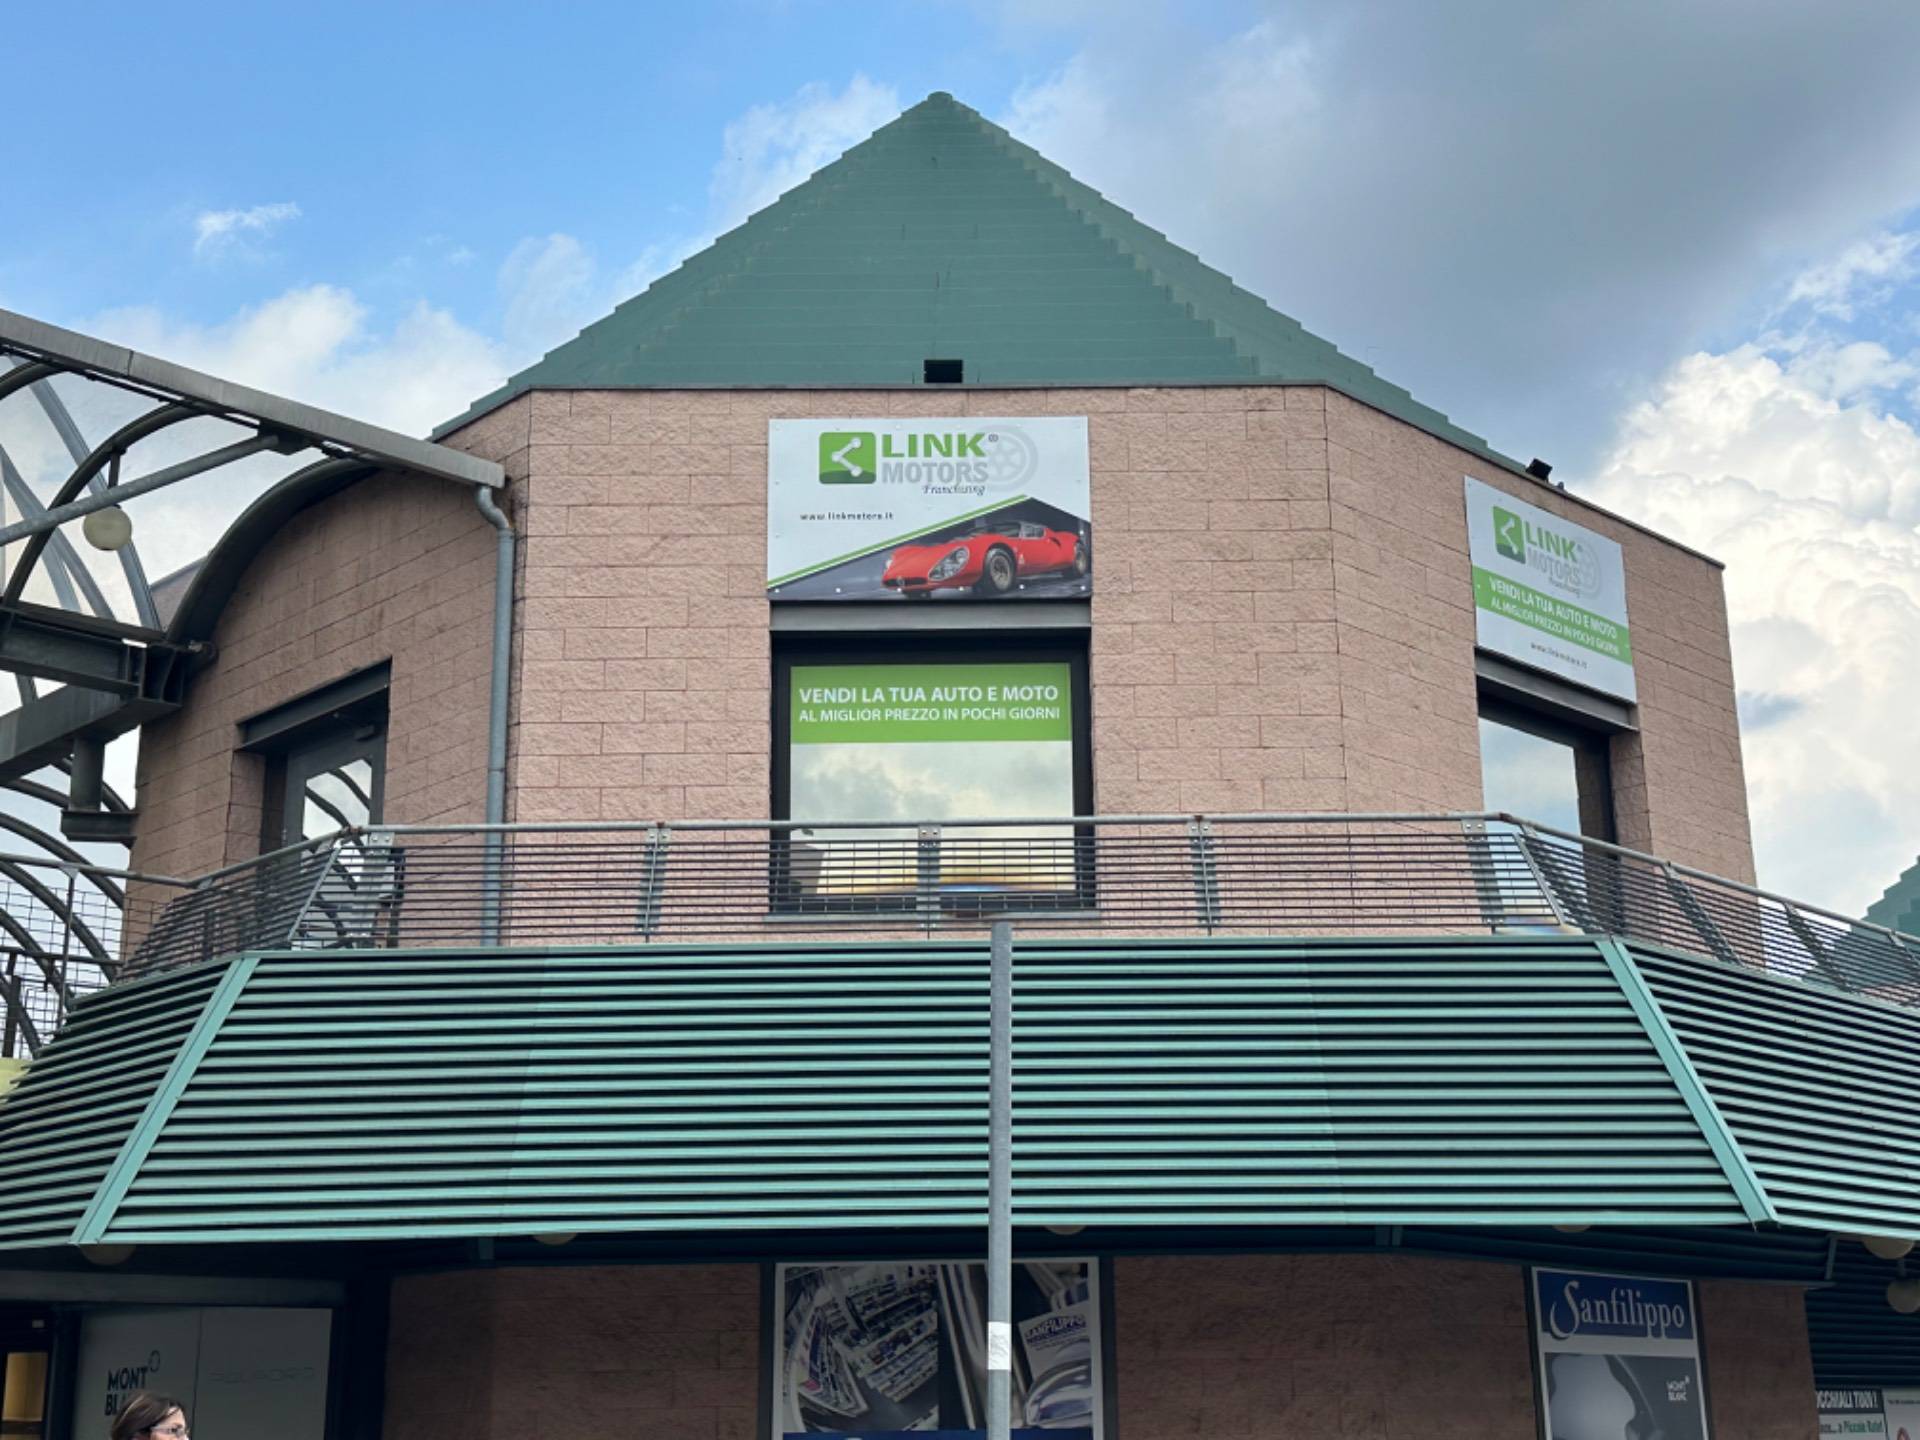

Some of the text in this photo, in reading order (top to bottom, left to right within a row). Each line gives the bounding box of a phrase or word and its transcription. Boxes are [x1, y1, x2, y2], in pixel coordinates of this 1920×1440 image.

[882, 433, 986, 458] LINK
[882, 462, 989, 484] MOTORS
[921, 484, 986, 496] Franchising
[800, 512, 894, 521] www.linkmotors.it
[1524, 520, 1579, 563] LINK
[1527, 548, 1581, 586] MOTORS
[1489, 575, 1618, 639] VENDI LA TUA AUTO E MOTO
[1491, 597, 1501, 611] AL
[799, 685, 1059, 704] VENDI LA TUA AUTO E MOTO
[799, 706, 1060, 721] AL MIGLIOR PREZZO IN POCHI GIORNI
[1550, 1280, 1686, 1341] Sanfilippo
[107, 1366, 149, 1391] MONT
